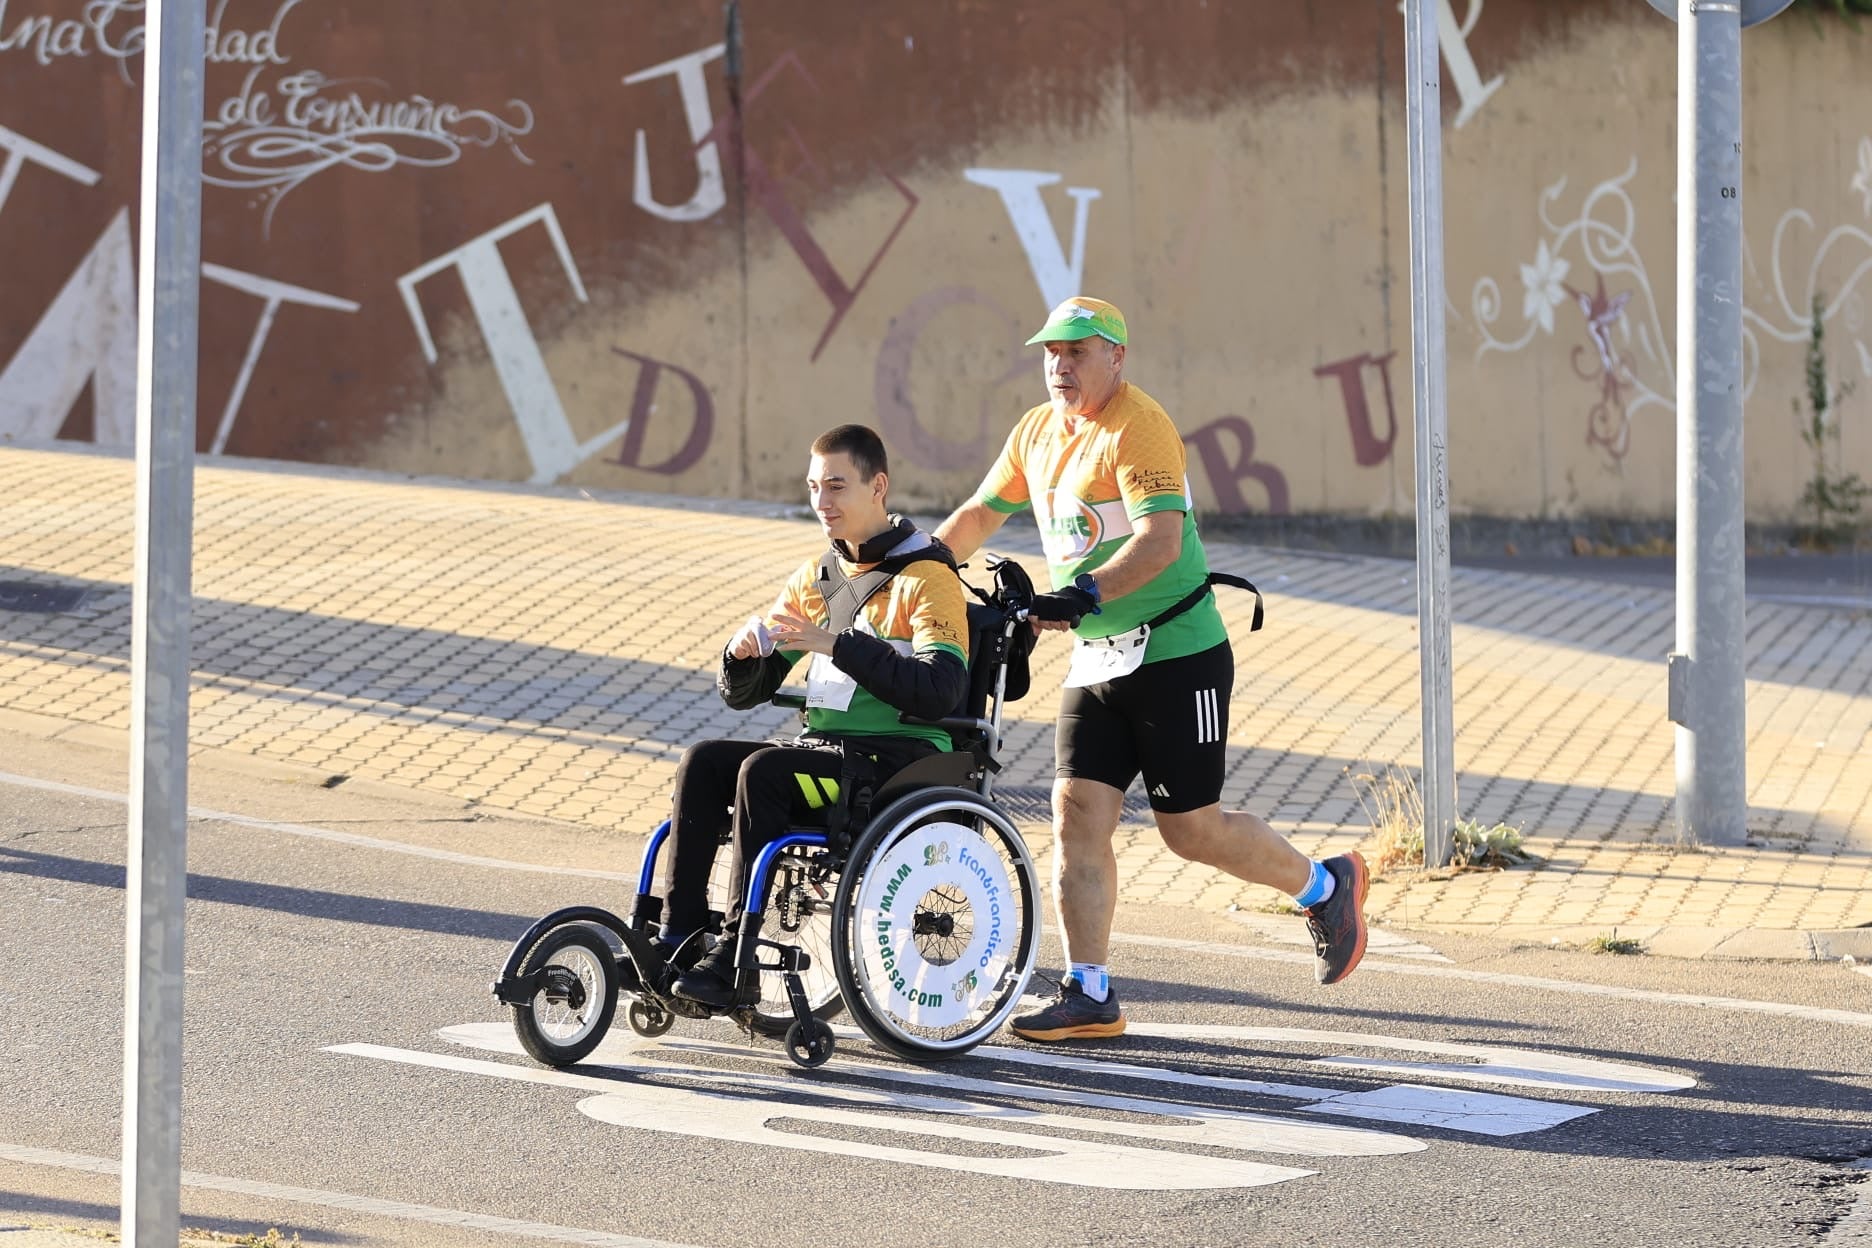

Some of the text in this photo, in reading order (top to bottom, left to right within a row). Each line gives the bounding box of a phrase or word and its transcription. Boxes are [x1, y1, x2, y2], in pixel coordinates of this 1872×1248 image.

[0, 0, 300, 87] na Cdad
[218, 65, 278, 130] de
[1721, 187, 1736, 199] 08
[602, 345, 716, 477] D
[1312, 350, 1398, 467] U
[878, 863, 943, 1008] www.hedasa.com
[959, 848, 1002, 968] Fran&Francisco
